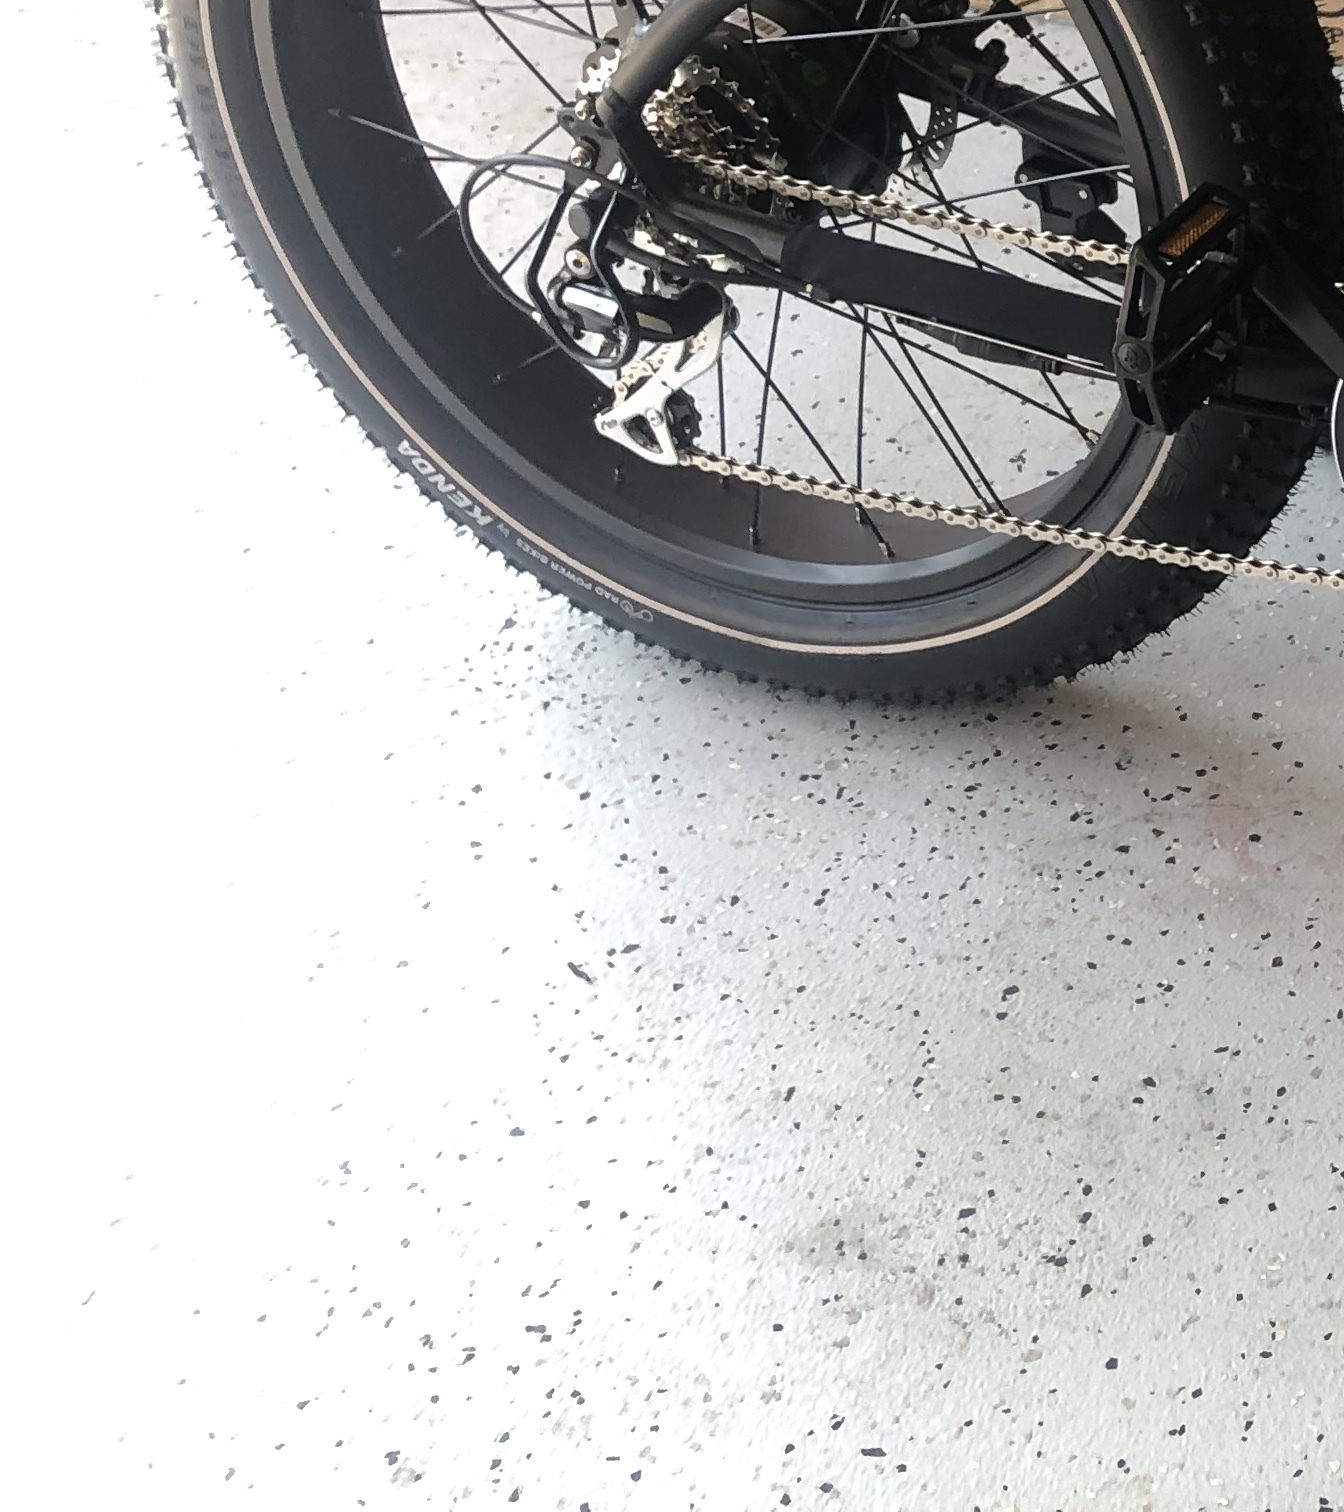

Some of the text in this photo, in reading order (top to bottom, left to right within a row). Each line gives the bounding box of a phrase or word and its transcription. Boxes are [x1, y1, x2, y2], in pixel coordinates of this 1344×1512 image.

[397, 439, 494, 526] KENDA
[516, 538, 549, 564] BIKES
[550, 559, 593, 590] POWER
[594, 585, 620, 605] RAD
